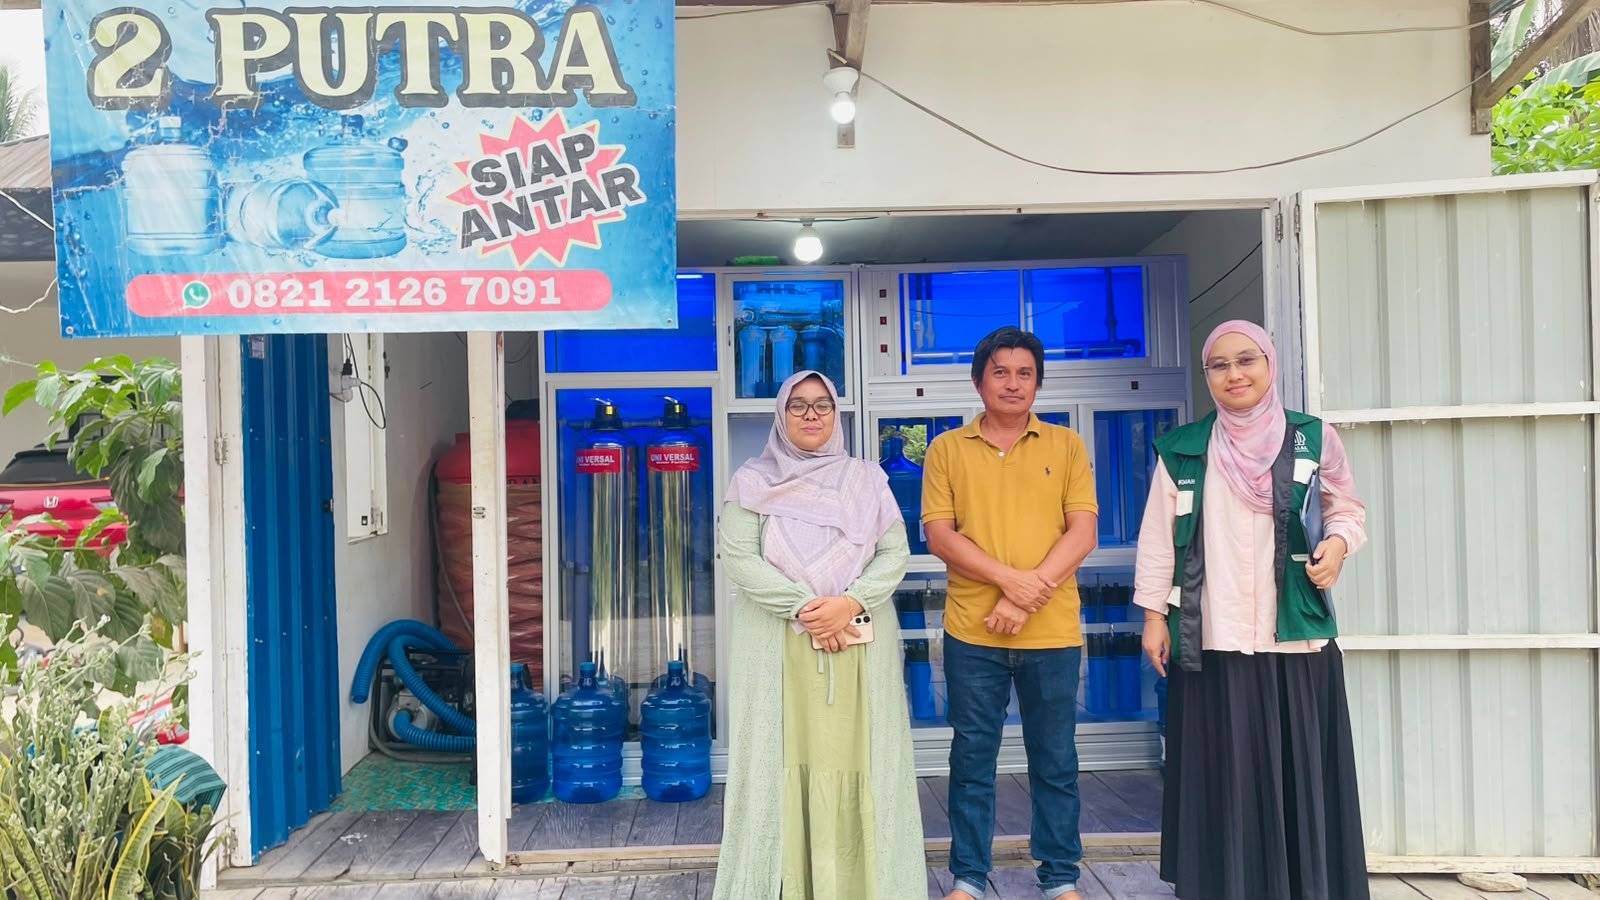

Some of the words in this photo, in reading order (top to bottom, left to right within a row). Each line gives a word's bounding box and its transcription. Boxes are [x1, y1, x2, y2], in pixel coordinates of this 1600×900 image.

[88, 6, 172, 111] 2
[205, 5, 637, 110] PUTRA
[470, 132, 596, 197] SIAP
[460, 166, 643, 250] ANTAR
[226, 278, 332, 309] 0821
[344, 277, 448, 307] 2126
[460, 276, 562, 306] 7091
[584, 455, 615, 463] VERSAL
[663, 453, 695, 461] VERSAL
